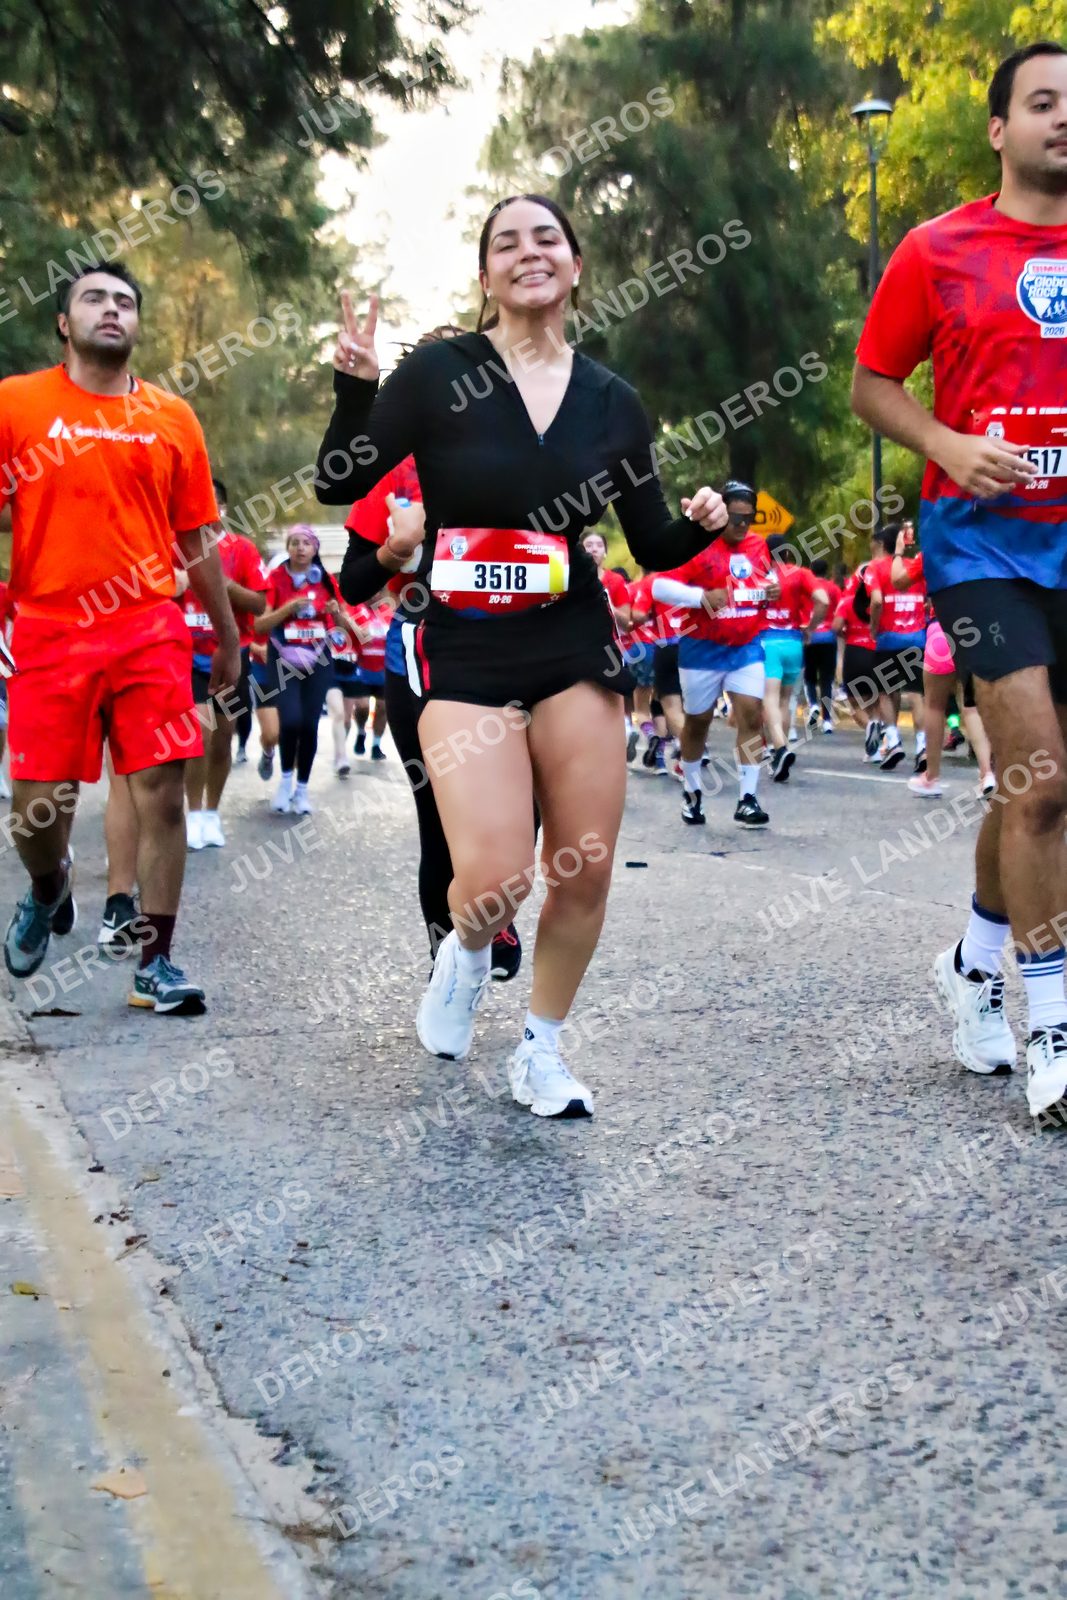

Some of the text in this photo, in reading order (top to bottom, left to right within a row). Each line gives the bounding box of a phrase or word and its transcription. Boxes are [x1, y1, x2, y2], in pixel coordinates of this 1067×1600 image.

[1034, 276, 1067, 287] Globa
[1028, 287, 1057, 297] Race
[1026, 449, 1061, 474] 517
[474, 564, 527, 590] 3518
[489, 595, 512, 604] 20-26
